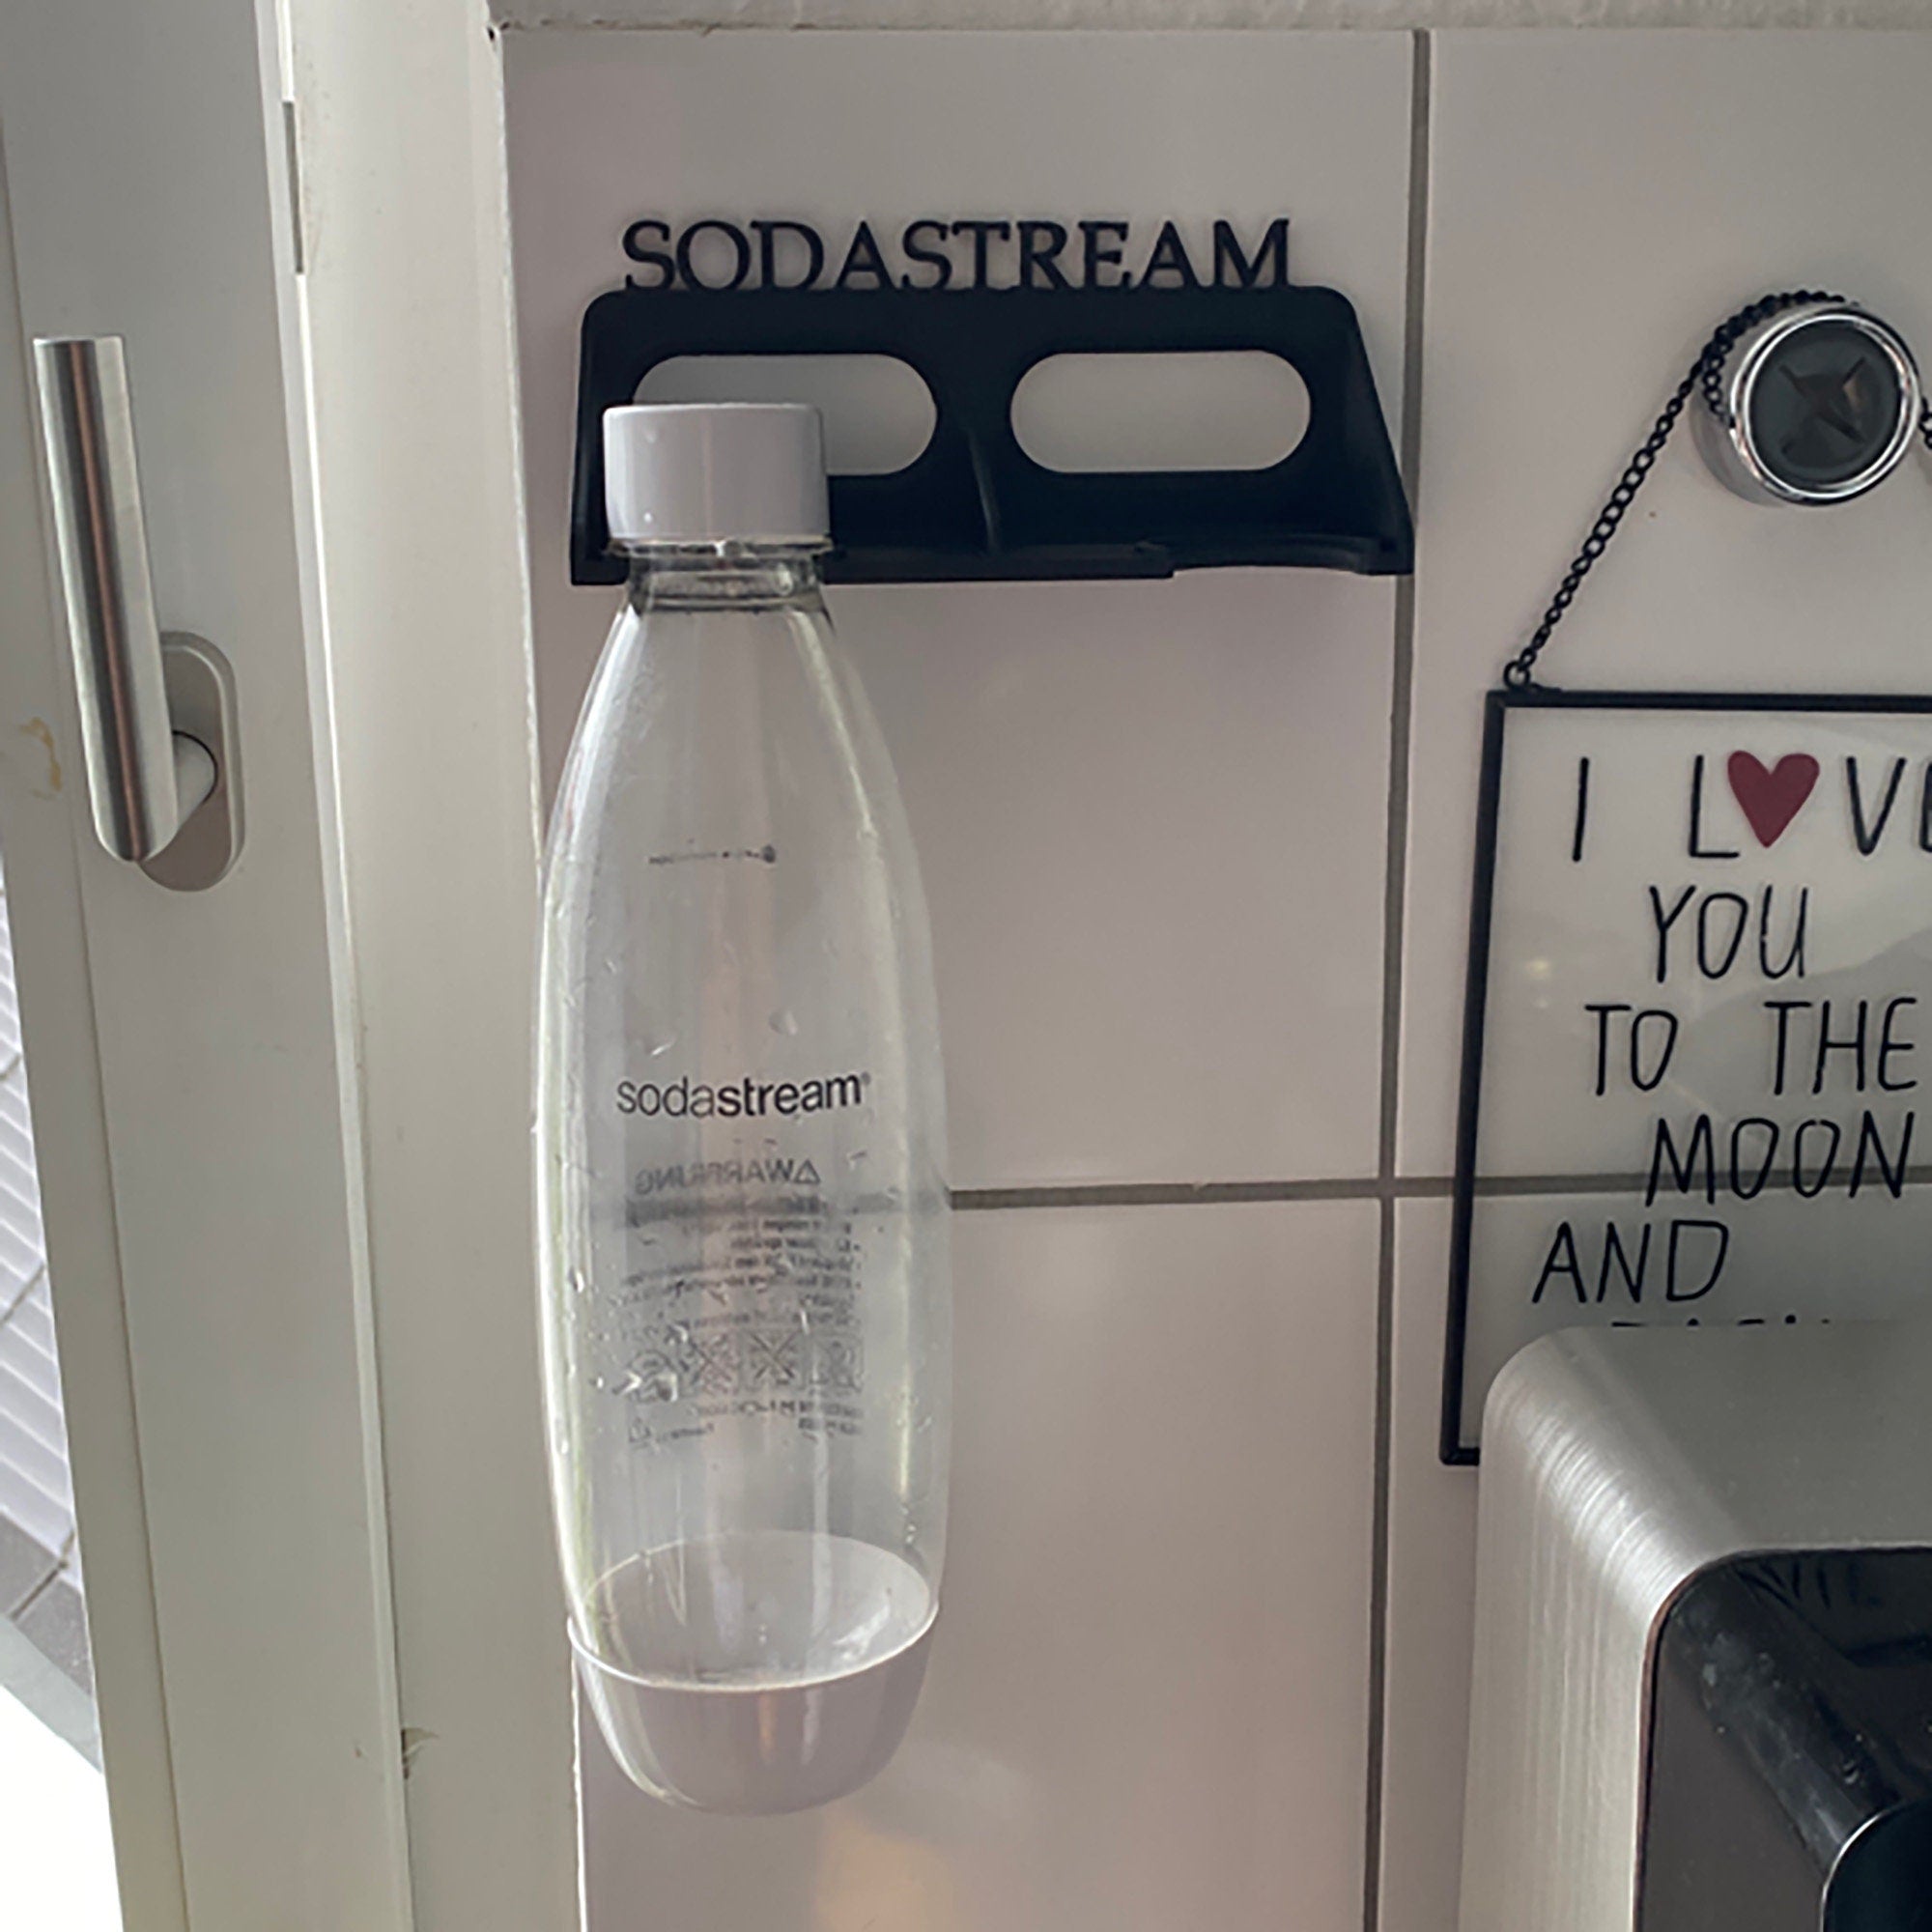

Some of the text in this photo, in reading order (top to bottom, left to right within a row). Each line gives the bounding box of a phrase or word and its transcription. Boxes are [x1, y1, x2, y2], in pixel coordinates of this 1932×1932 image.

[621, 218, 1291, 290] SODASTREAM
[1572, 756, 1590, 863] I
[1648, 885, 1809, 983] YOU
[1584, 997, 1918, 1096] TO THE
[616, 1073, 863, 1119] sodastream
[1646, 1110, 1917, 1208] MOON
[1531, 1219, 1730, 1304] AND
